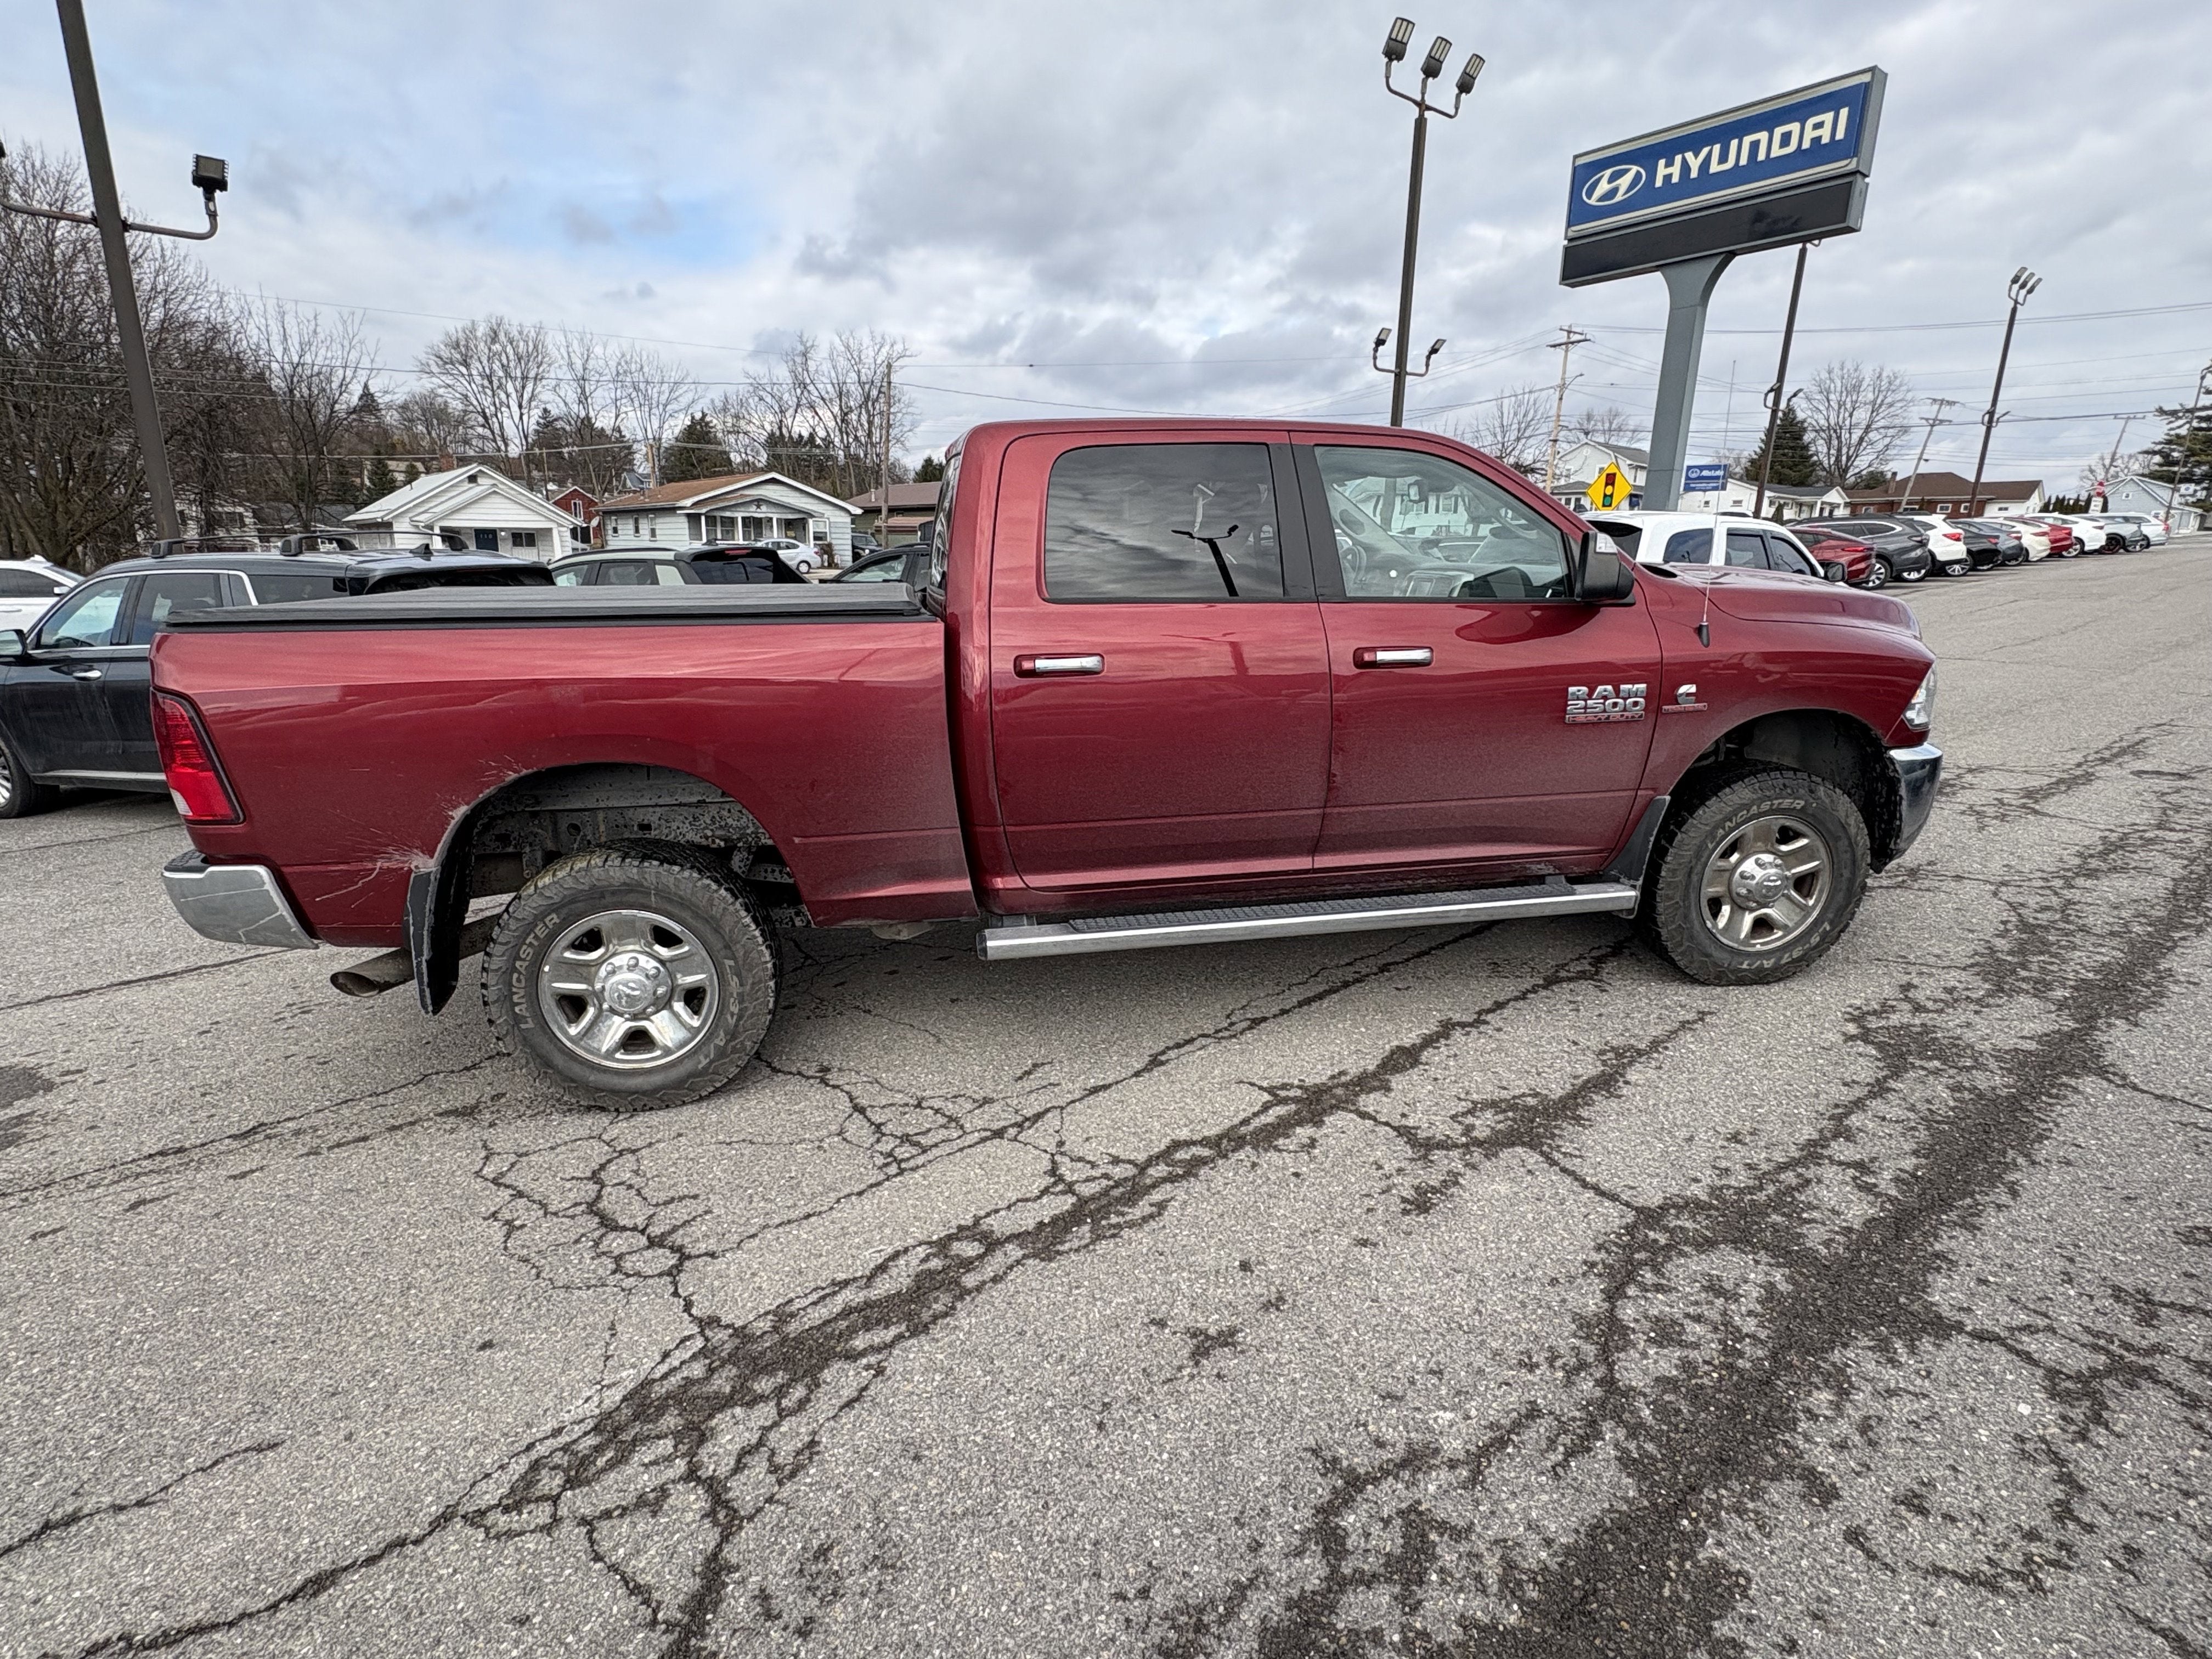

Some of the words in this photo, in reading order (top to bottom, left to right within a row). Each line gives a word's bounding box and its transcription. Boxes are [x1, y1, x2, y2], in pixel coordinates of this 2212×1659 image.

[1655, 106, 1849, 188] HYUNDAI
[1566, 697, 1645, 714] 2500
[1567, 684, 1647, 699] RAM
[1706, 799, 1805, 850] LANCASTER
[511, 913, 560, 1029] LANCASTER
[1737, 957, 1776, 969] A/T
